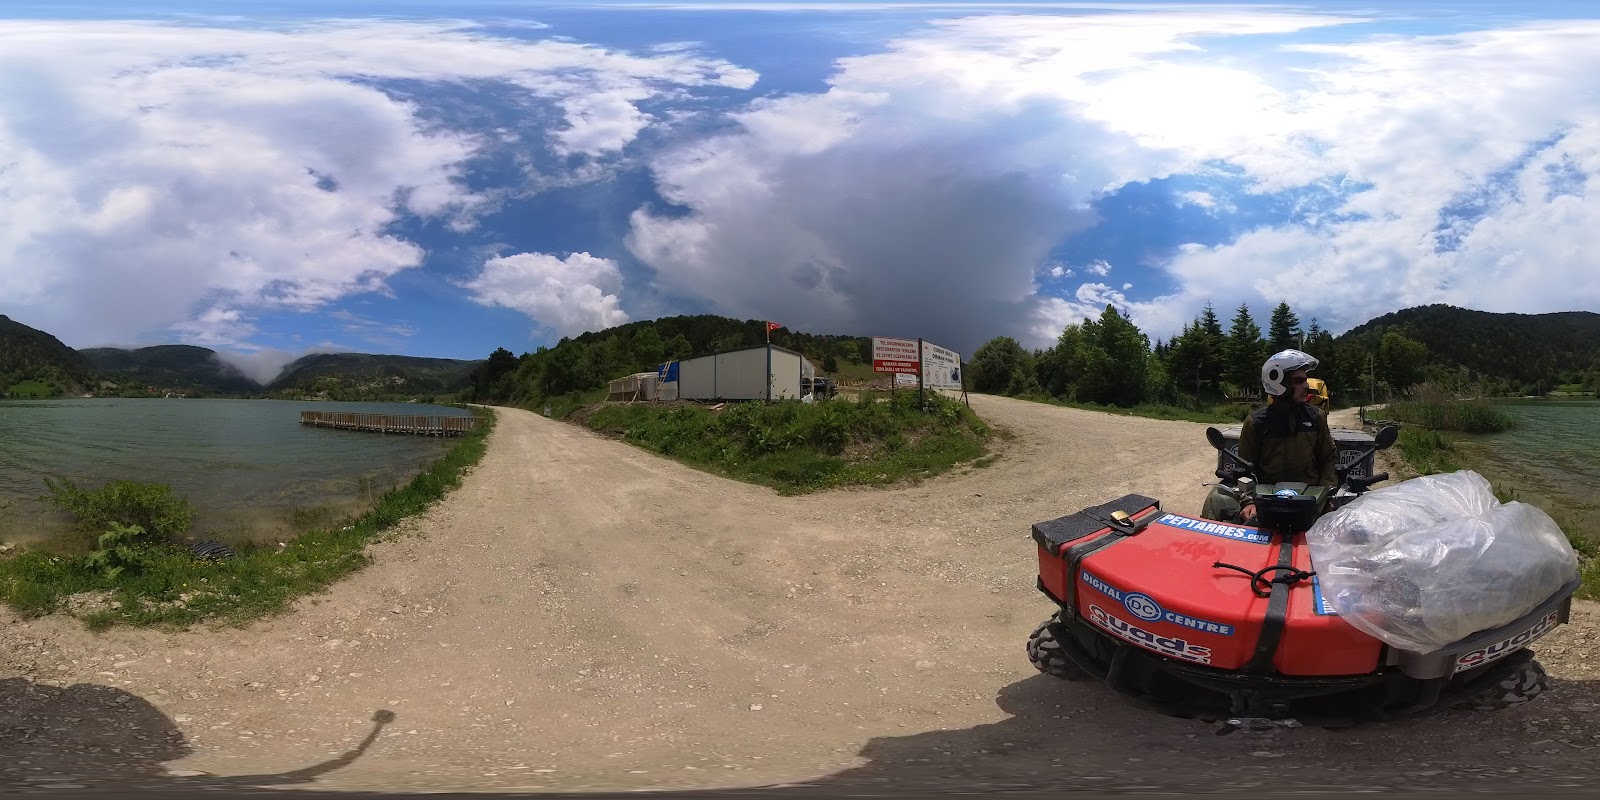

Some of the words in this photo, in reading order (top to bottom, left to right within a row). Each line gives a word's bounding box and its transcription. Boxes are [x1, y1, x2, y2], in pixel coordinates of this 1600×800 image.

[1082, 571, 1122, 601] DIGITAL
[1131, 598, 1154, 616] DC
[1088, 603, 1212, 659] Quads
[1165, 612, 1230, 635] CENTRE
[1456, 609, 1559, 664] Quads
